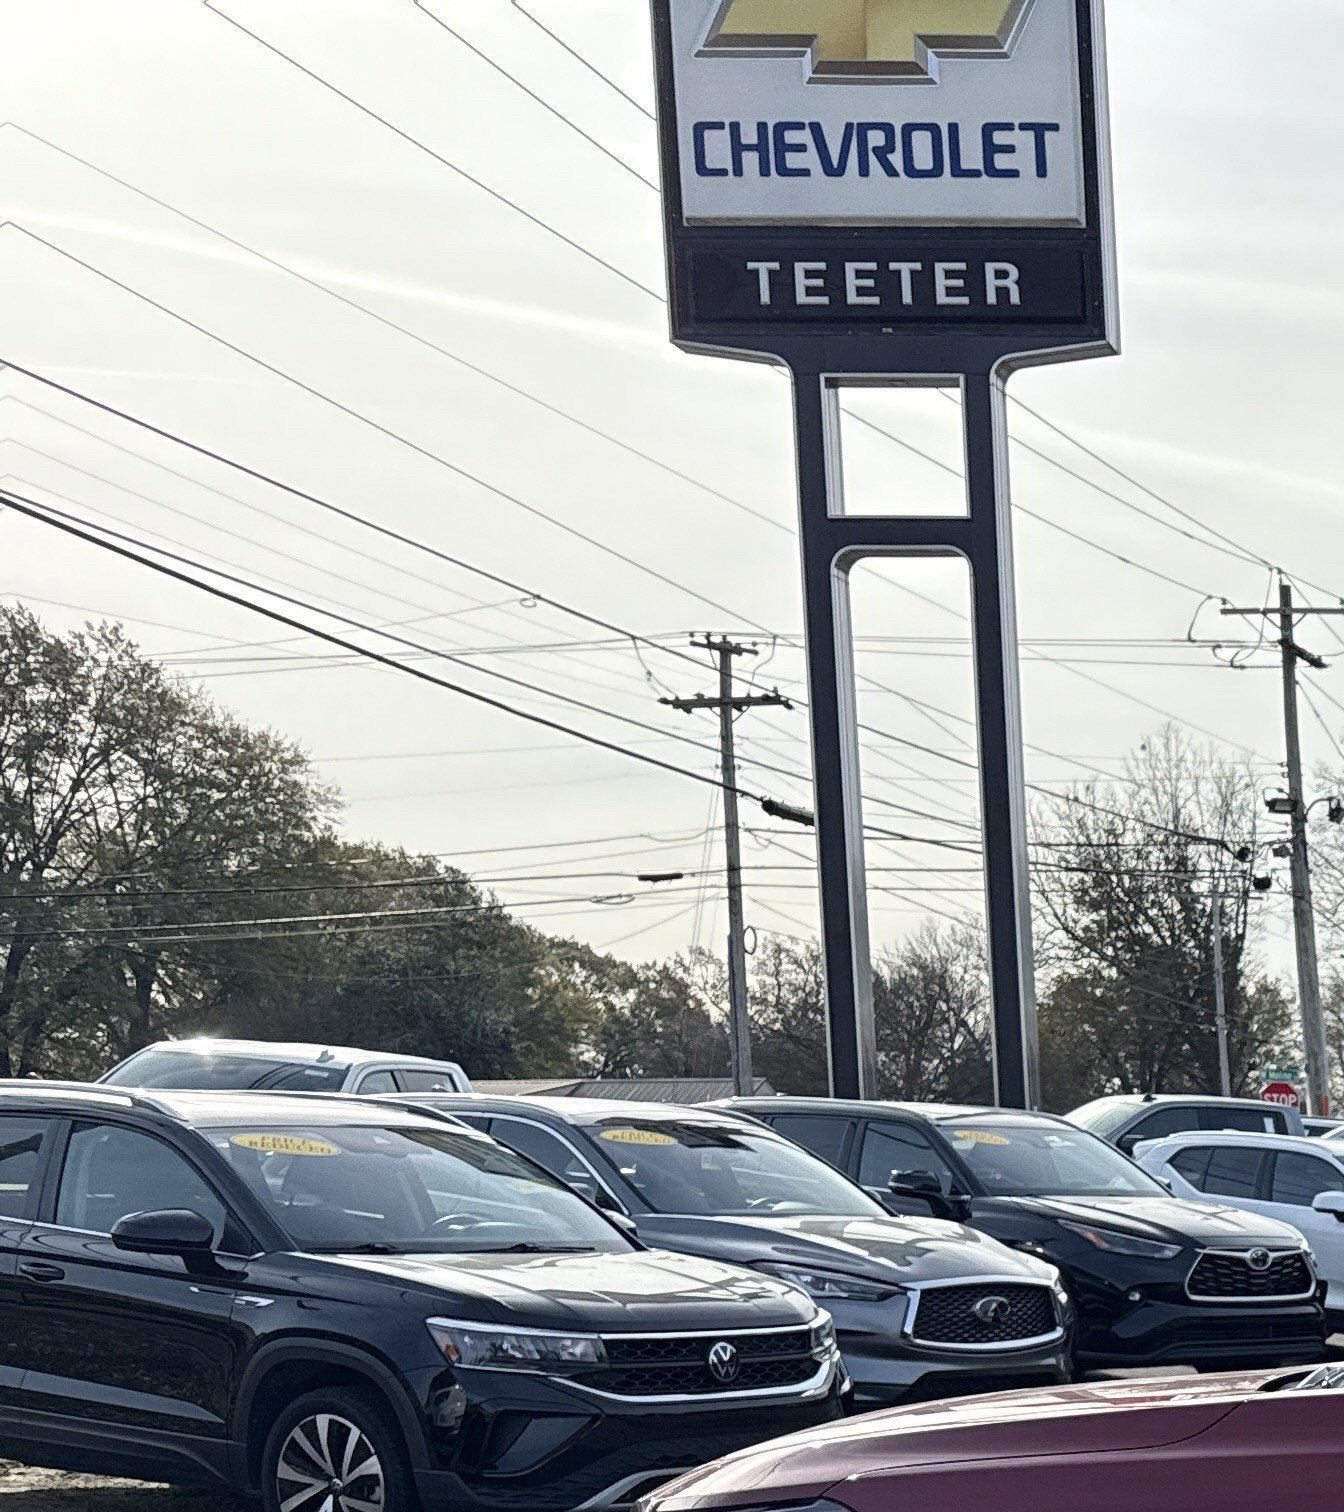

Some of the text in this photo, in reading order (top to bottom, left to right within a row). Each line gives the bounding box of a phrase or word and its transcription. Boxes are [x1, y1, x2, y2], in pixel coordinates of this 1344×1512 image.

[692, 120, 1060, 179] CHEVROLET
[746, 261, 1022, 306] TEETER
[1263, 1093, 1298, 1107] STOP
